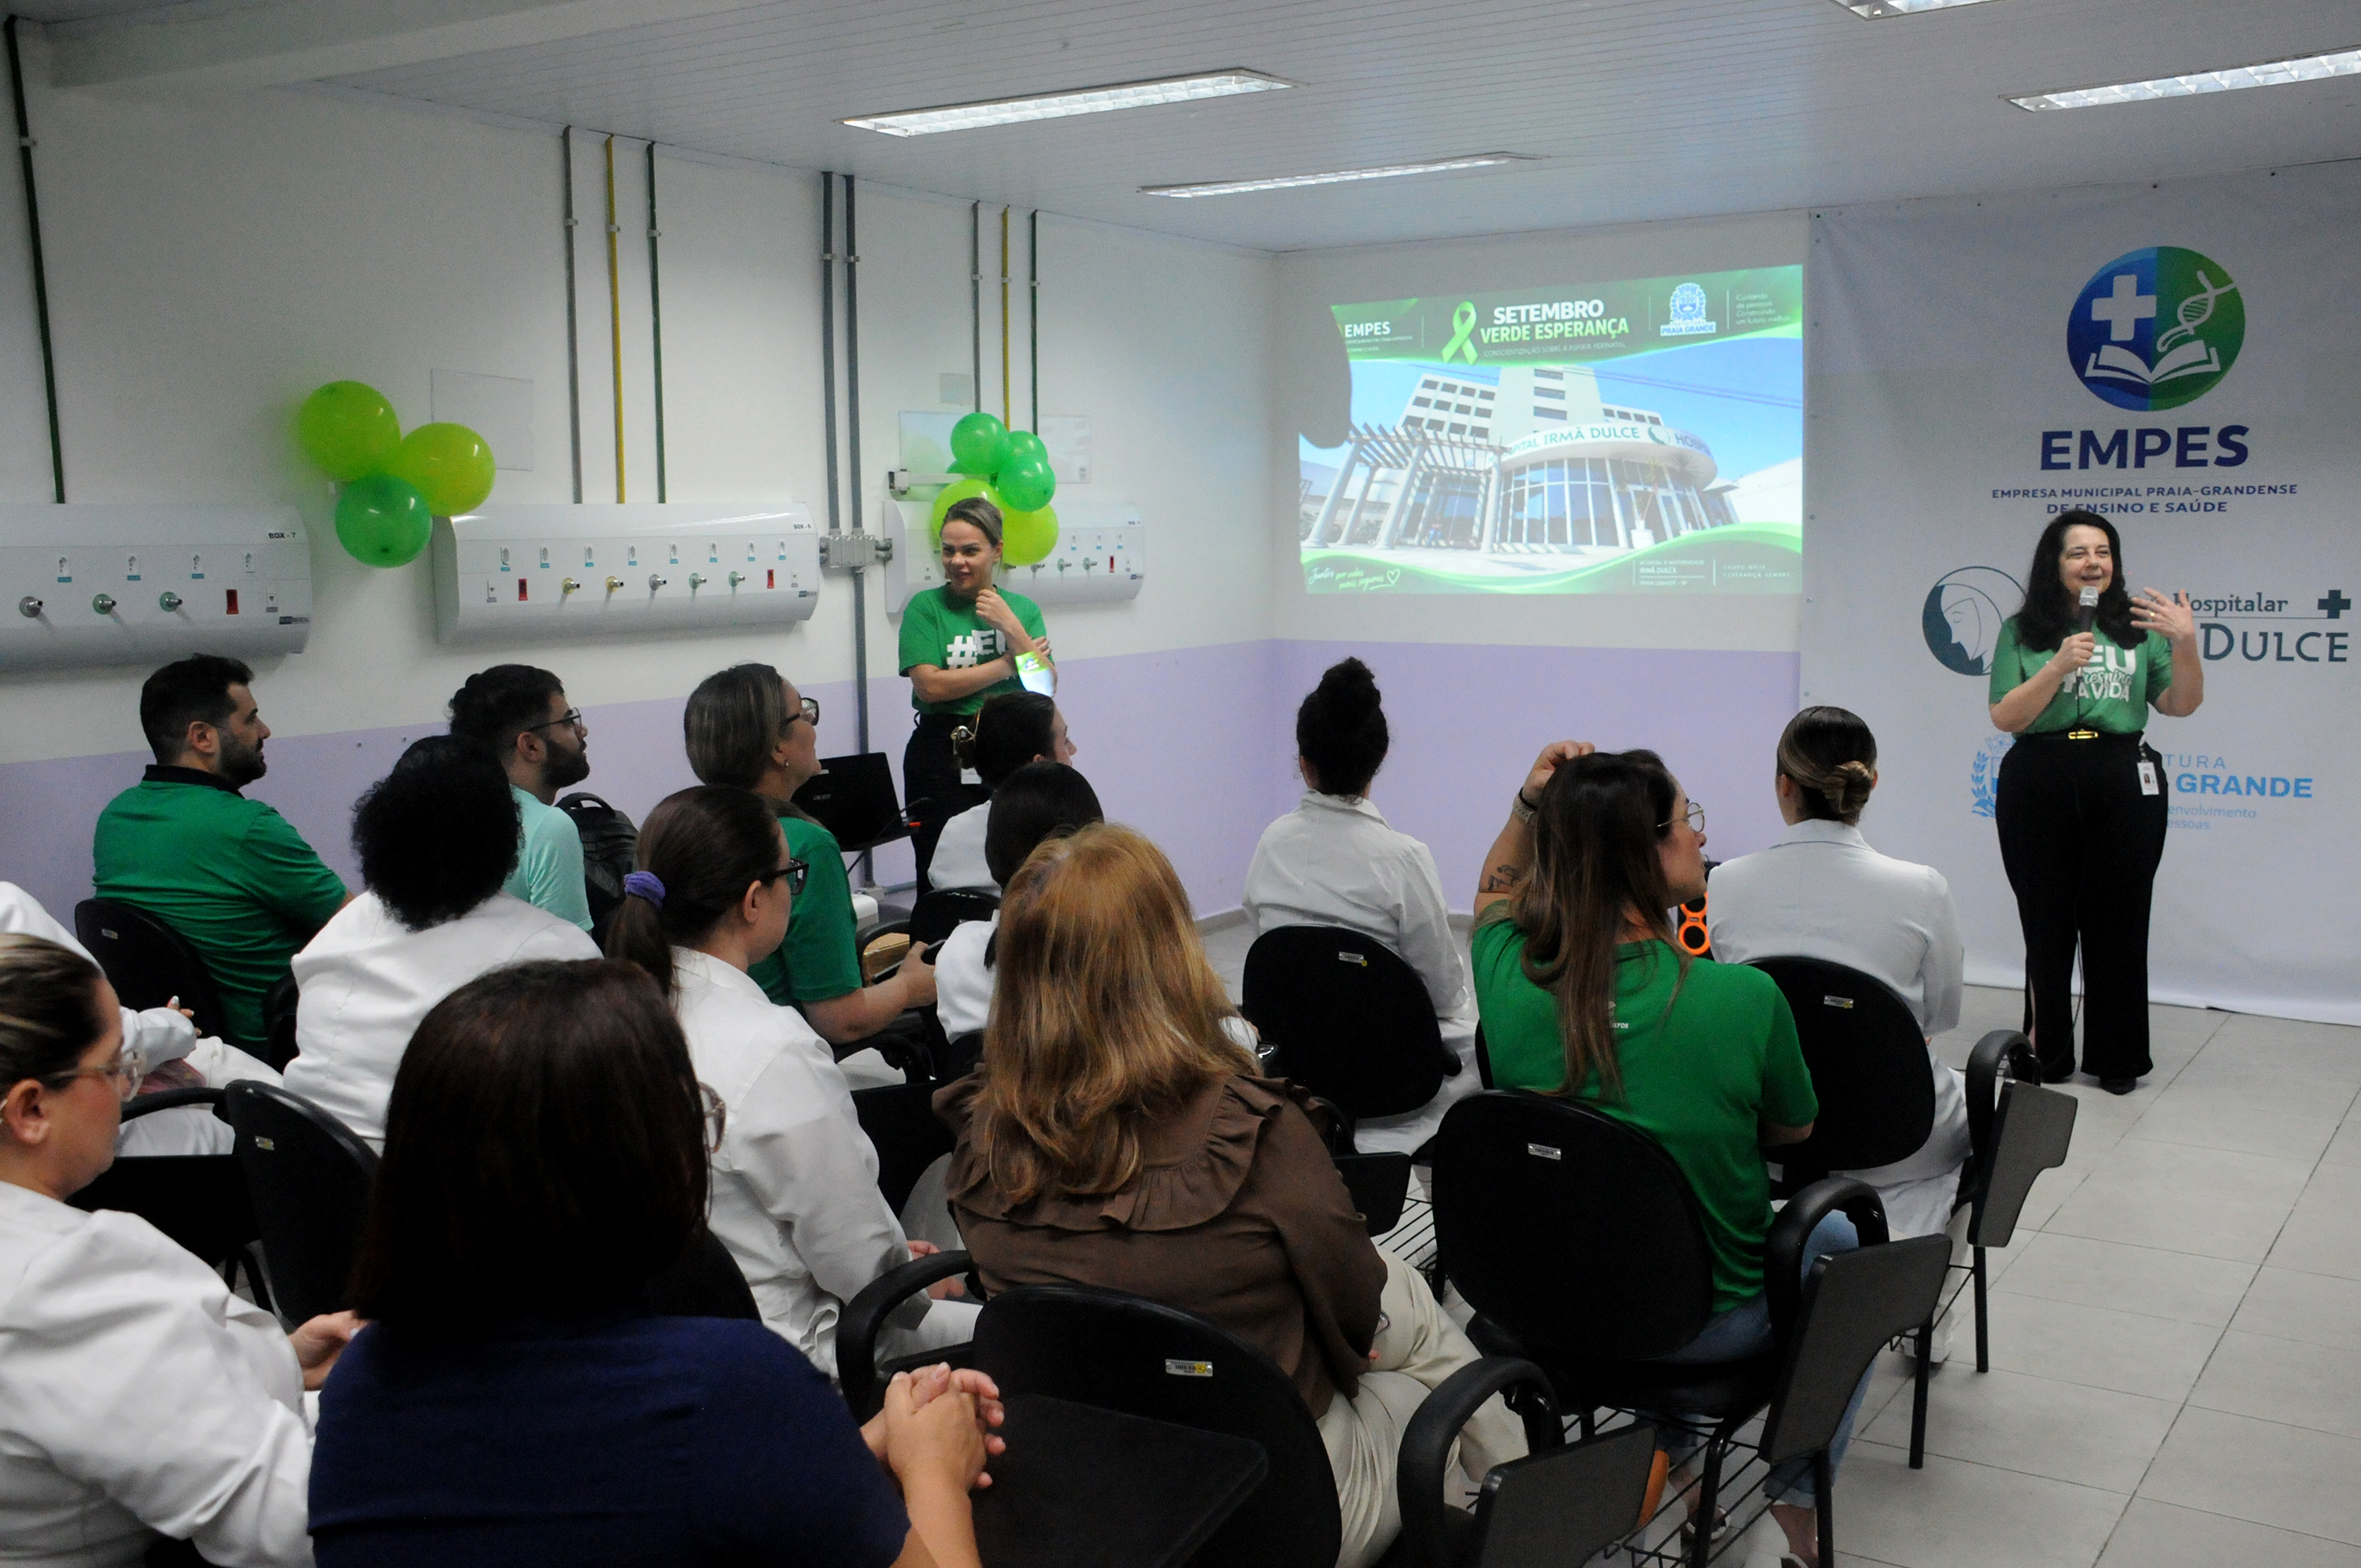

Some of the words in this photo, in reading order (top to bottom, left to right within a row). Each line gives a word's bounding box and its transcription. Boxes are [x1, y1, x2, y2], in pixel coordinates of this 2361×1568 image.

[1493, 299, 1605, 324] SETEMBRO
[1344, 321, 1391, 338] EMPES
[1480, 325, 1532, 344] VERDE
[1535, 317, 1630, 339] ESPERANÇA
[1684, 324, 1714, 333] GRANDE
[1543, 426, 1585, 445] IRMÃ
[1590, 426, 1640, 439] DULCE
[2040, 424, 2250, 471] EMPES
[1992, 488, 2057, 499] EMPRESA
[2061, 487, 2142, 498] MUNICIPAL
[2146, 484, 2298, 497] PRAIA-GRANDENSE
[2046, 504, 2069, 514] DE
[2075, 502, 2145, 514] ENSINO
[2149, 502, 2160, 513] E
[2164, 499, 2228, 514] SAÚDE
[2200, 622, 2349, 662] DULCE
[2090, 682, 2130, 703] VIDA
[2164, 754, 2226, 769] TURA
[2175, 773, 2313, 799] GRANDE
[2167, 804, 2257, 819] envolvimento
[2167, 820, 2210, 829] essoas
